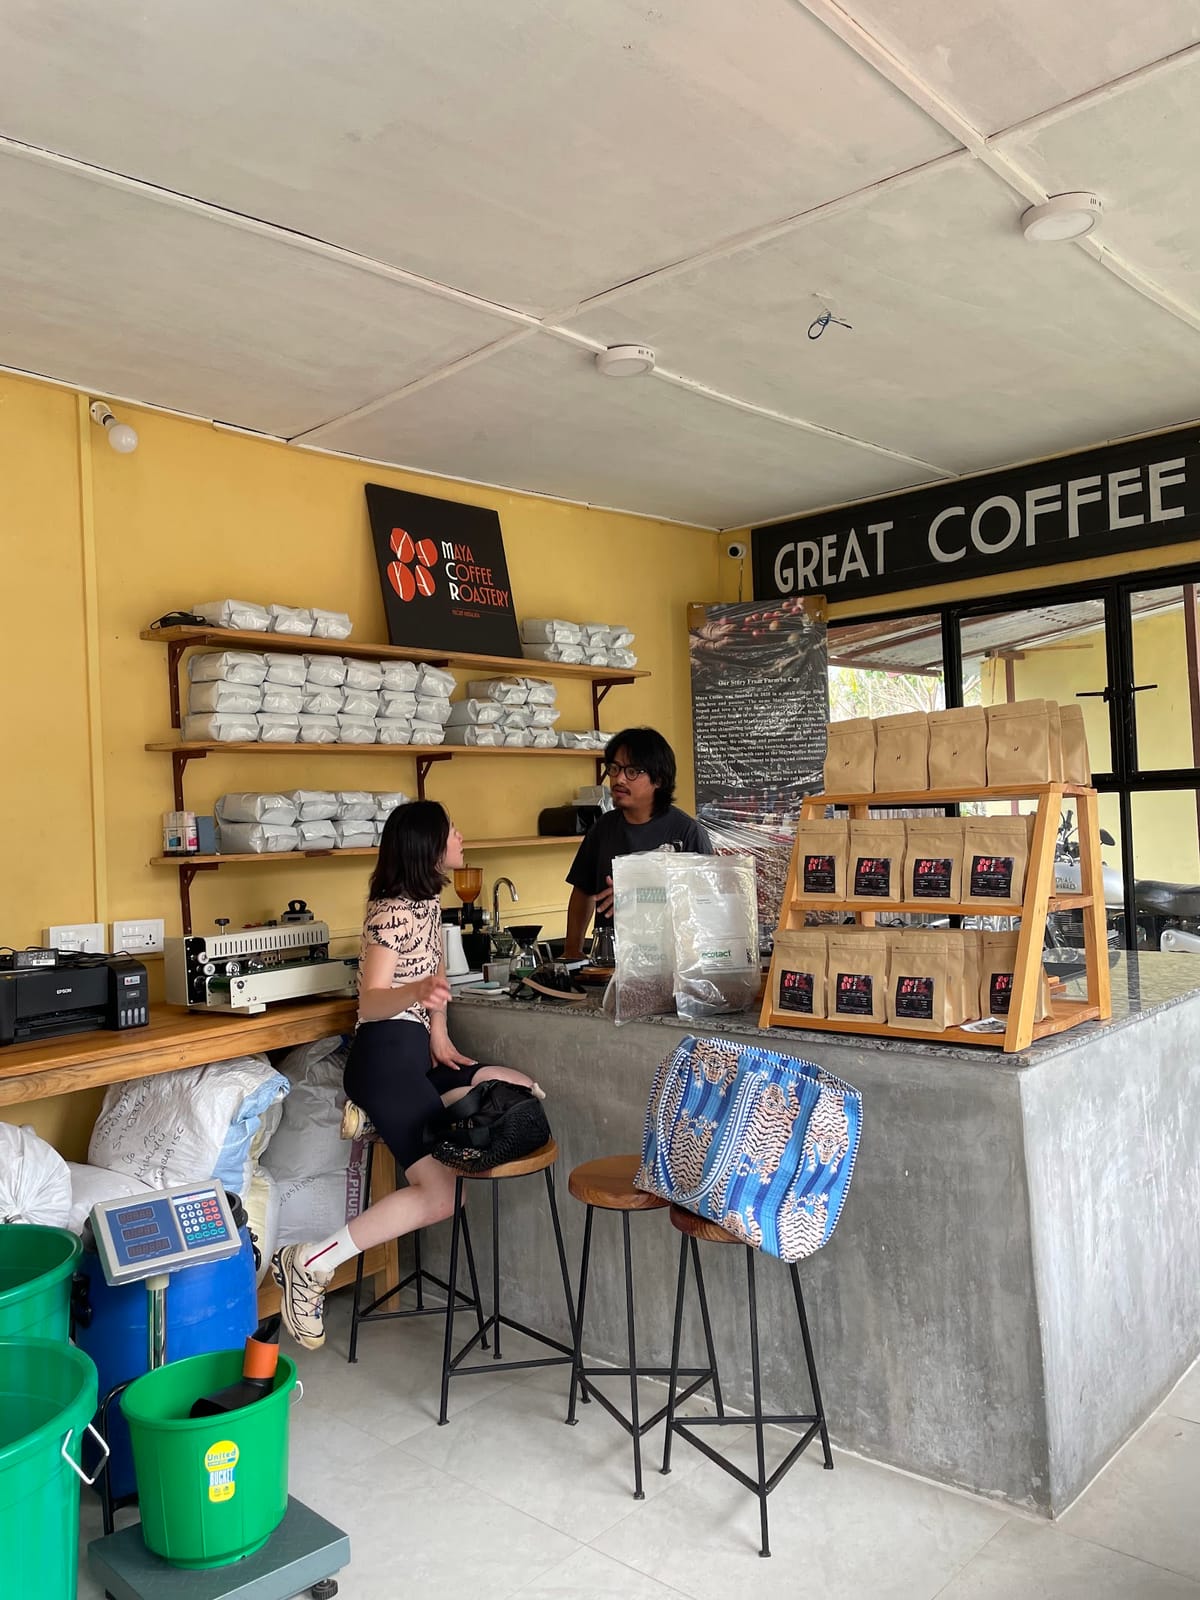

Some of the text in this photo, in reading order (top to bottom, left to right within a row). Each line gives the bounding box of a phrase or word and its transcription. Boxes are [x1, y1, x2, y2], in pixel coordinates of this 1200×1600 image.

[774, 457, 1187, 594] GREAT COFFEE
[441, 541, 475, 564] MAYA
[445, 562, 494, 587] COFFEE
[449, 582, 510, 608] ROASTERY
[701, 949, 731, 959] ecotact
[56, 988, 73, 996] EPSON
[207, 1449, 236, 1462] United
